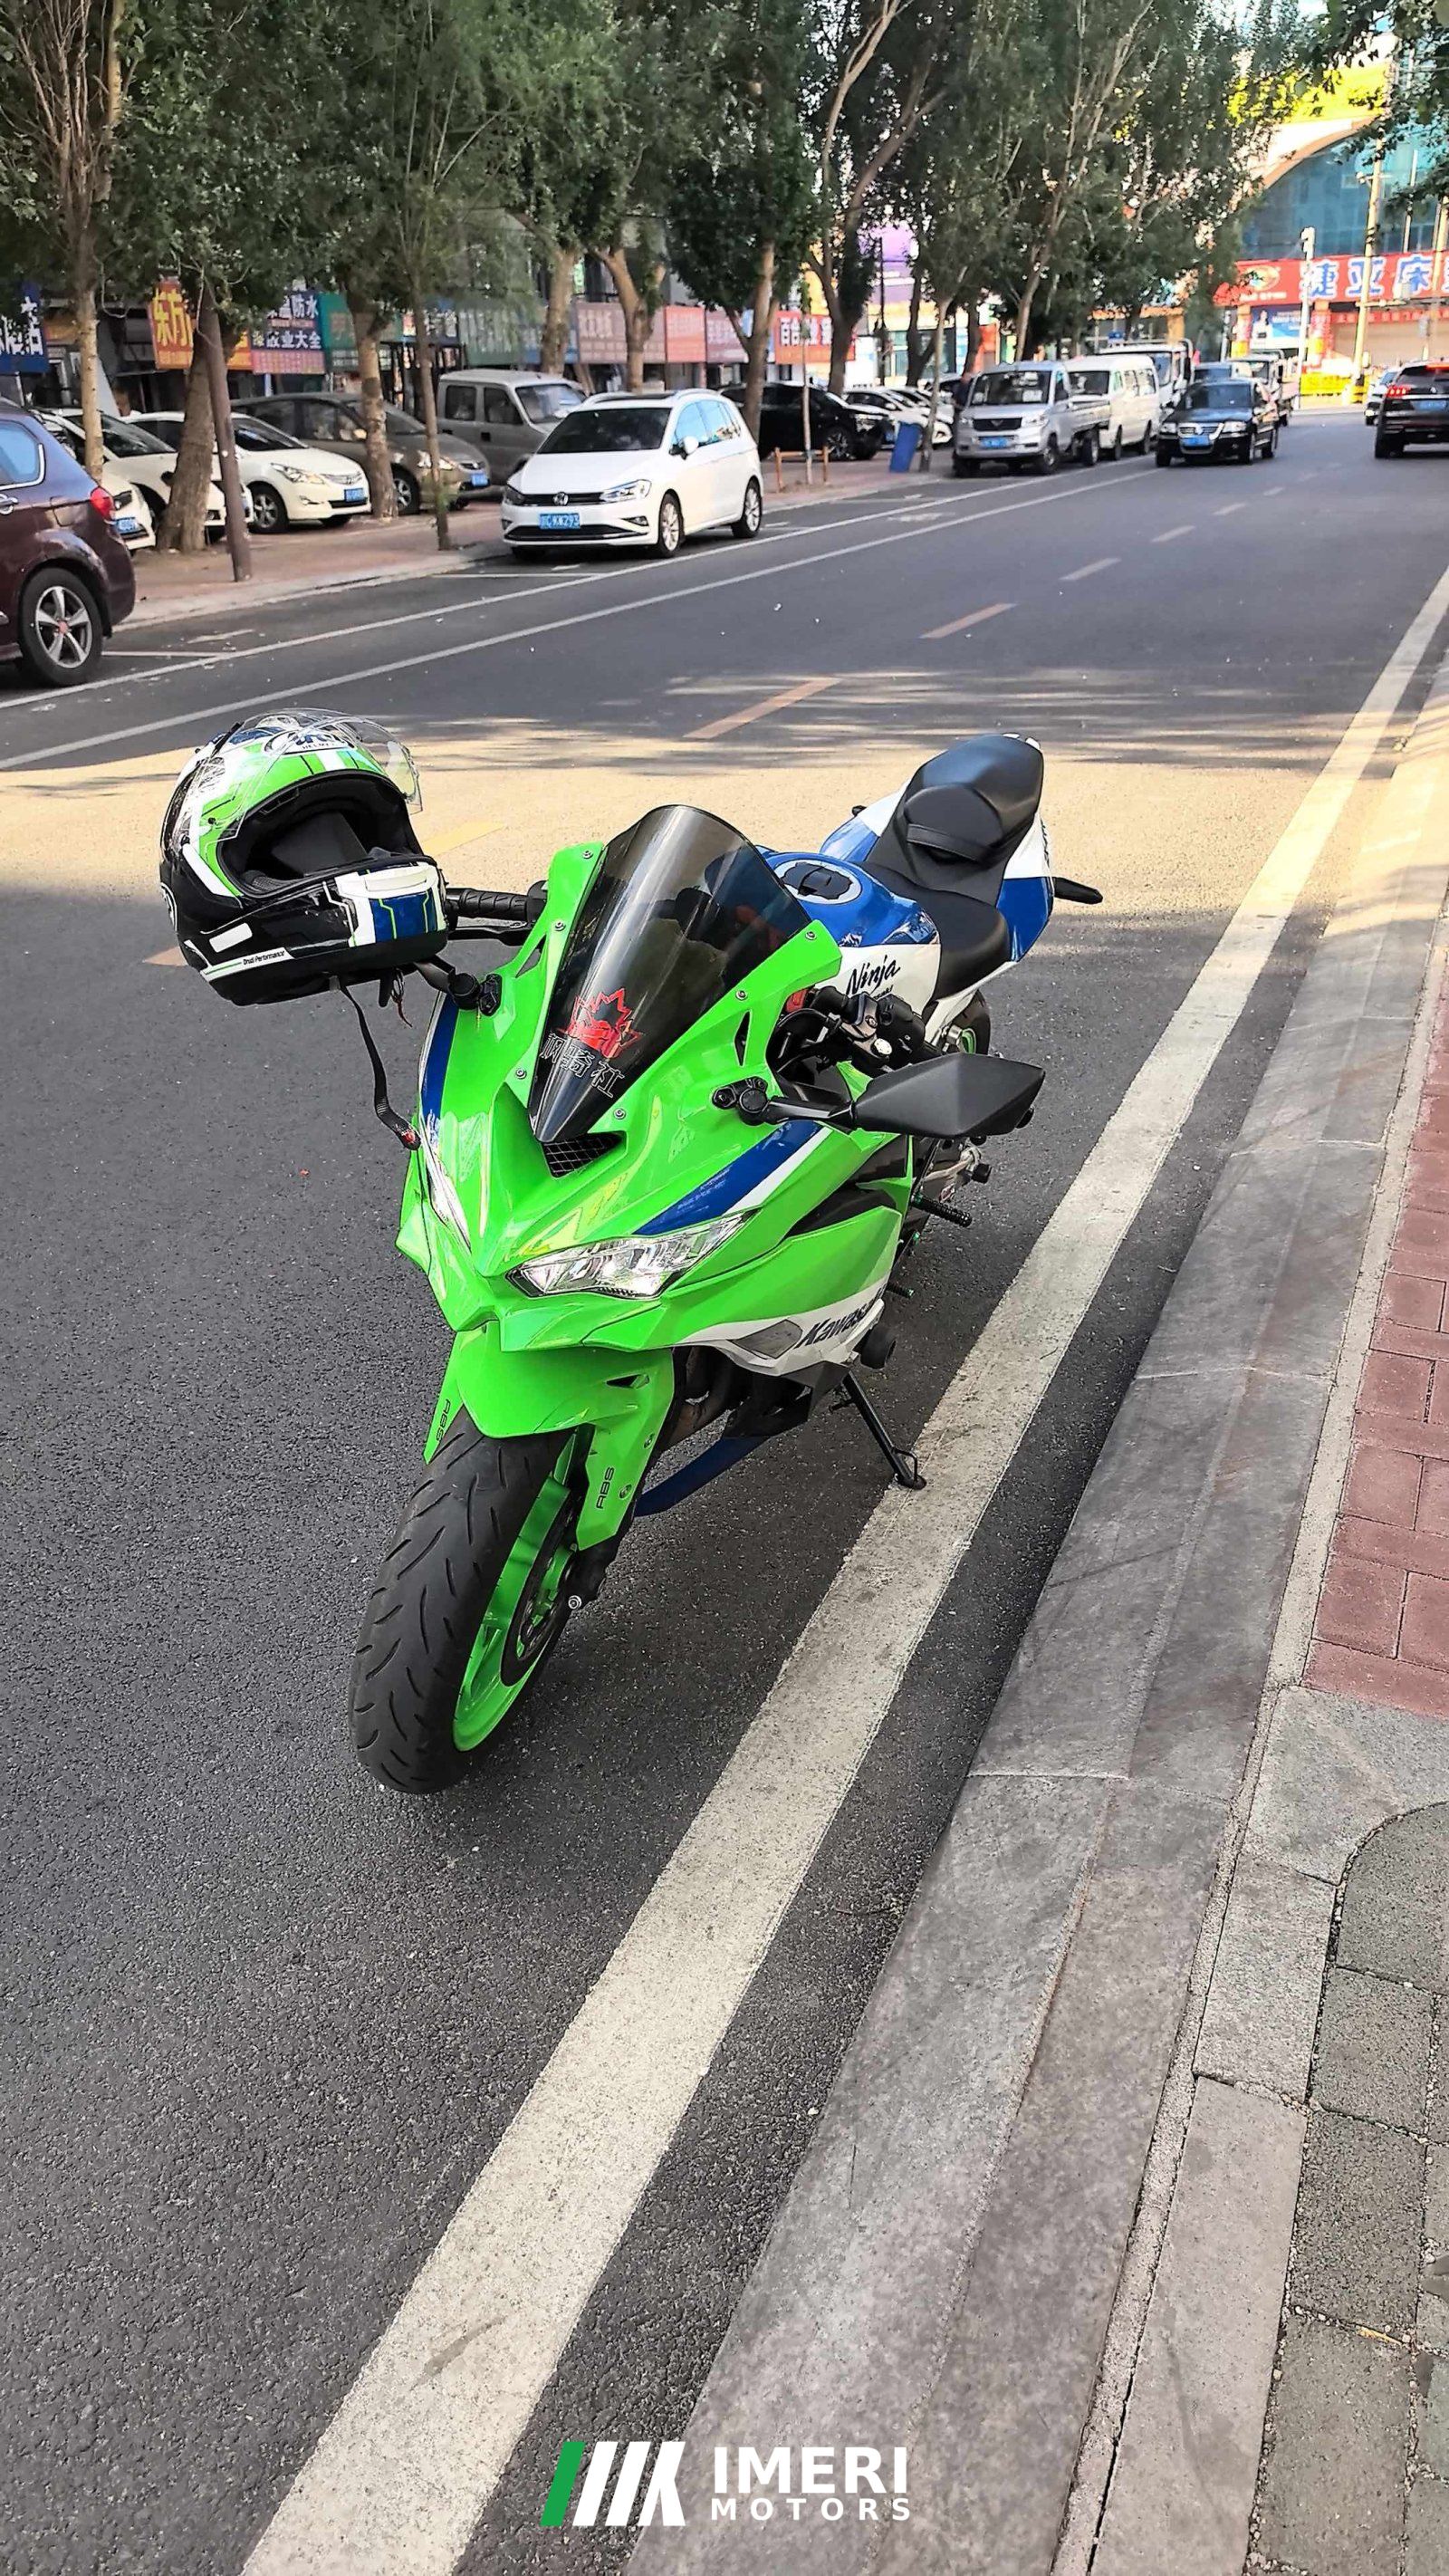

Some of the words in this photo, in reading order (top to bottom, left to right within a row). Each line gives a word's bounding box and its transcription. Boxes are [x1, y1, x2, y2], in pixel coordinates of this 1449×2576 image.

[845, 954, 901, 995] Ninja
[436, 1399, 451, 1441] ABS
[596, 1466, 615, 1510] ABS
